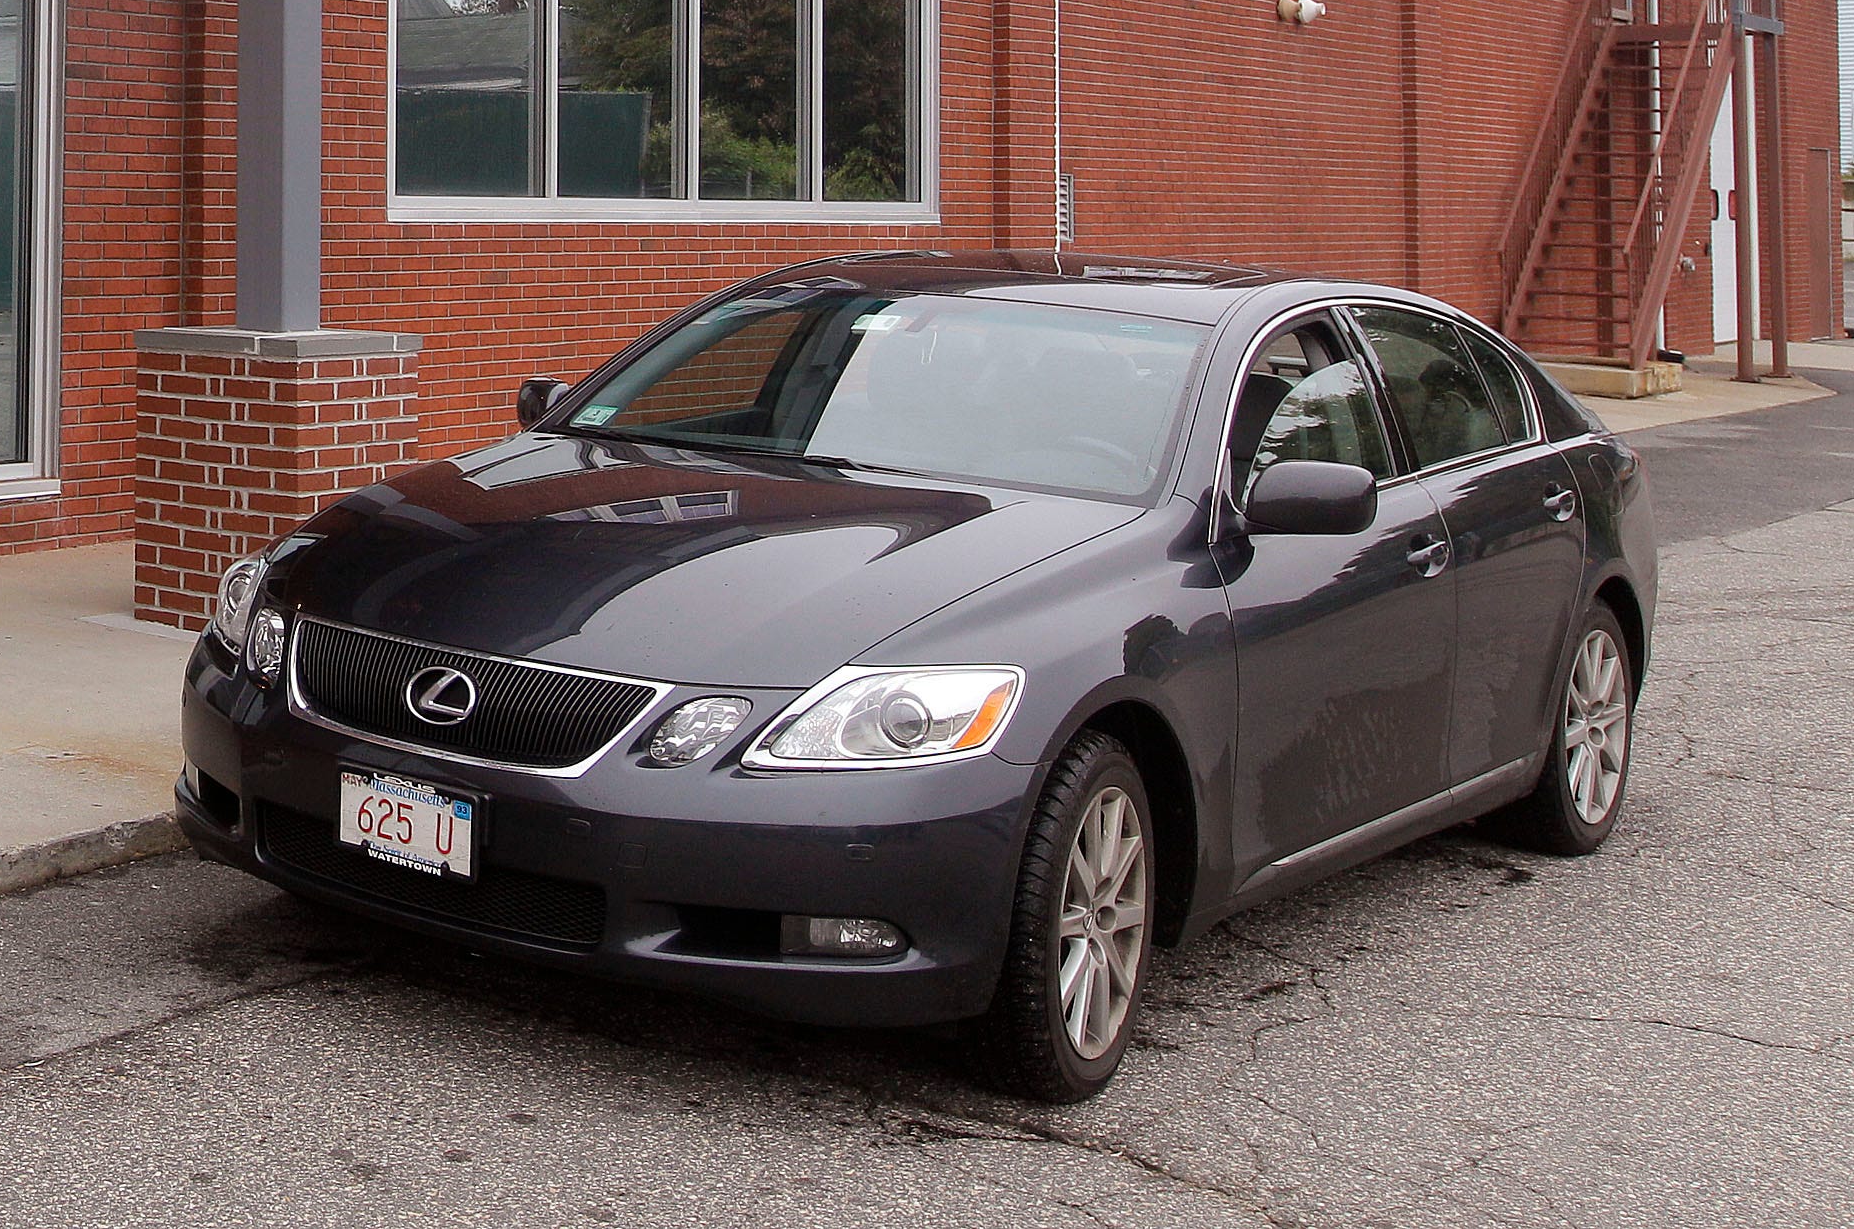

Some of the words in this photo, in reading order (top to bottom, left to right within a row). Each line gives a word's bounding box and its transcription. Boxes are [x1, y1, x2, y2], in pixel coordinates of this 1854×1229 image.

[342, 774, 364, 787] MAY
[373, 772, 436, 794] LEXUS
[456, 805, 467, 815] 93
[357, 795, 414, 844] 625
[436, 812, 453, 854] U
[367, 848, 442, 876] WATERTOWN
